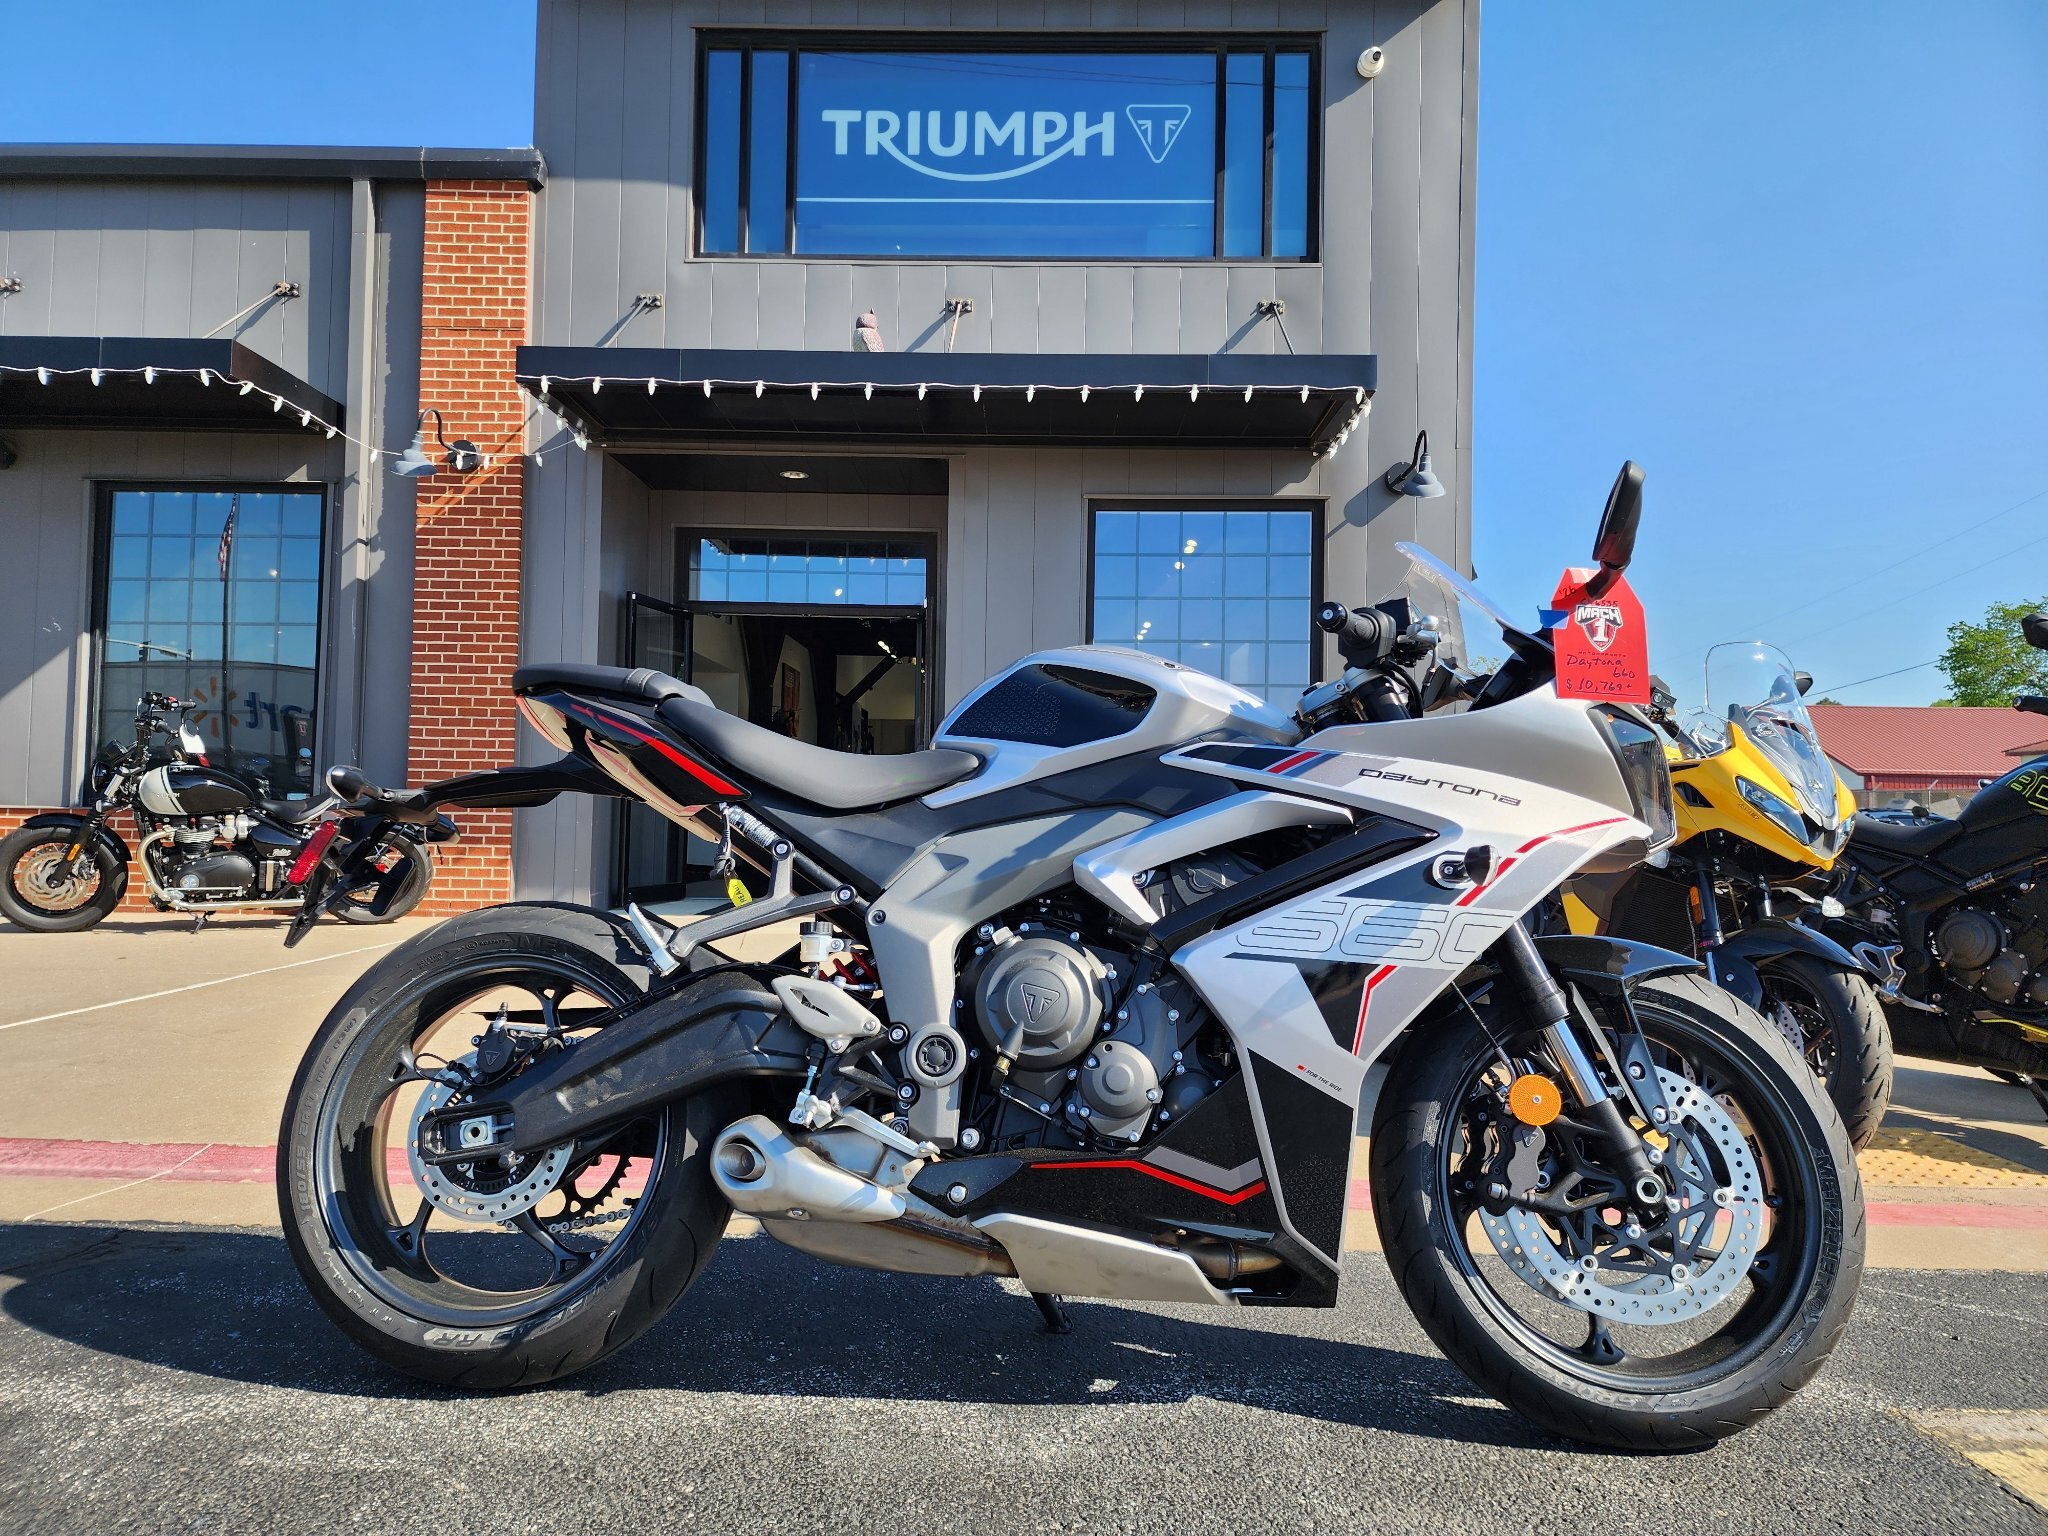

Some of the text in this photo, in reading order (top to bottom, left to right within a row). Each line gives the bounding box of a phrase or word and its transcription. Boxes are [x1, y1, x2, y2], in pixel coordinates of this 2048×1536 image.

[822, 110, 1114, 182] TRIUMPH
[1577, 605, 1622, 626] MACH
[1593, 617, 1608, 642] 1
[1567, 655, 1622, 669] Daytona
[1613, 668, 1635, 678] 660
[1306, 1070, 1342, 1092] FOR THE RIDE
